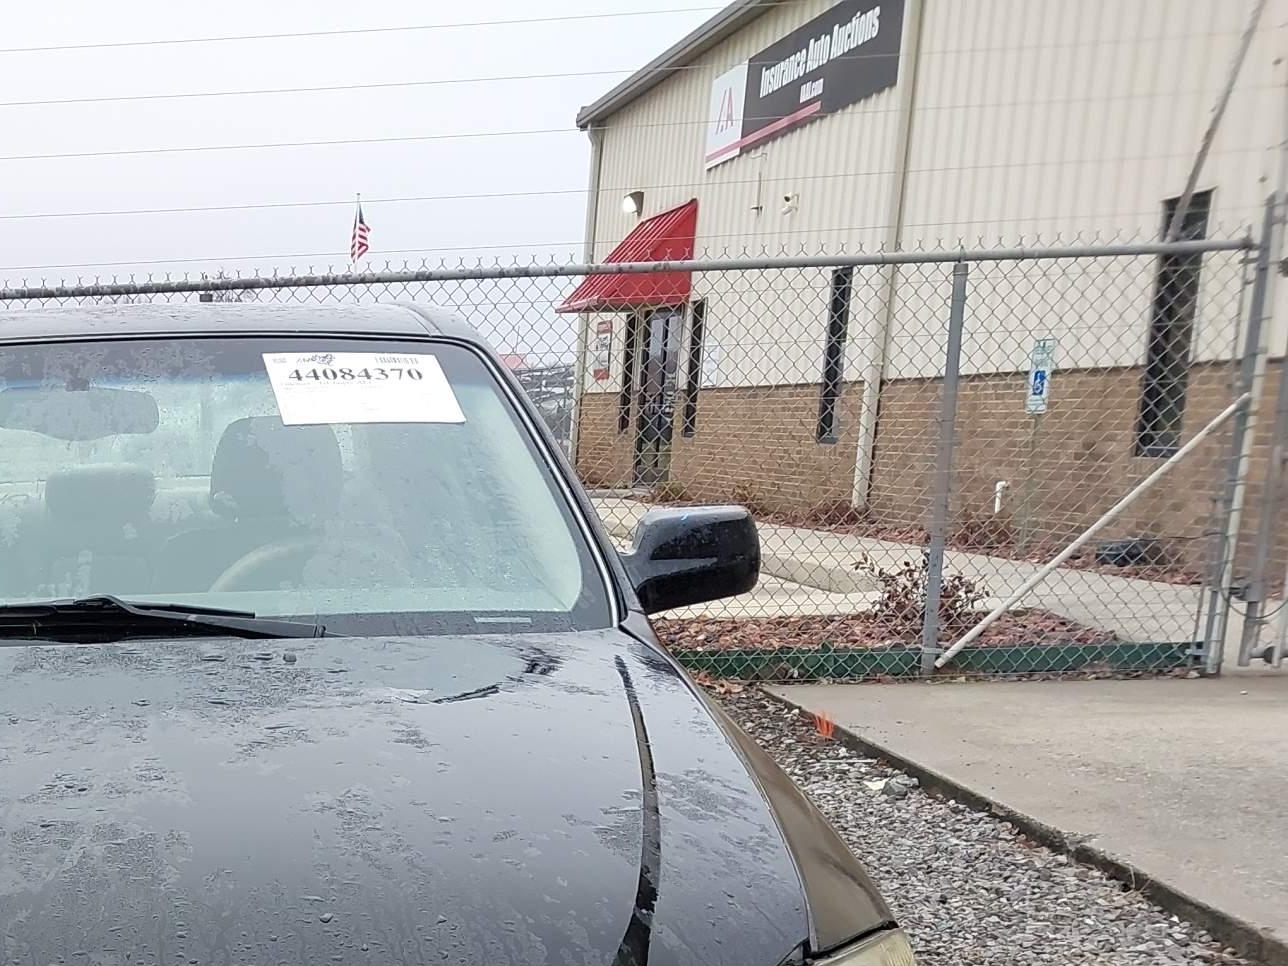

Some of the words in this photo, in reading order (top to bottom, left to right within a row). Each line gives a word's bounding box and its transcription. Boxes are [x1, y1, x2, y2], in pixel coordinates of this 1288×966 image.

[759, 48, 807, 98] Insurance
[806, 34, 831, 74] Auto
[829, 6, 881, 60] Auctions
[288, 367, 423, 382] 44084370
